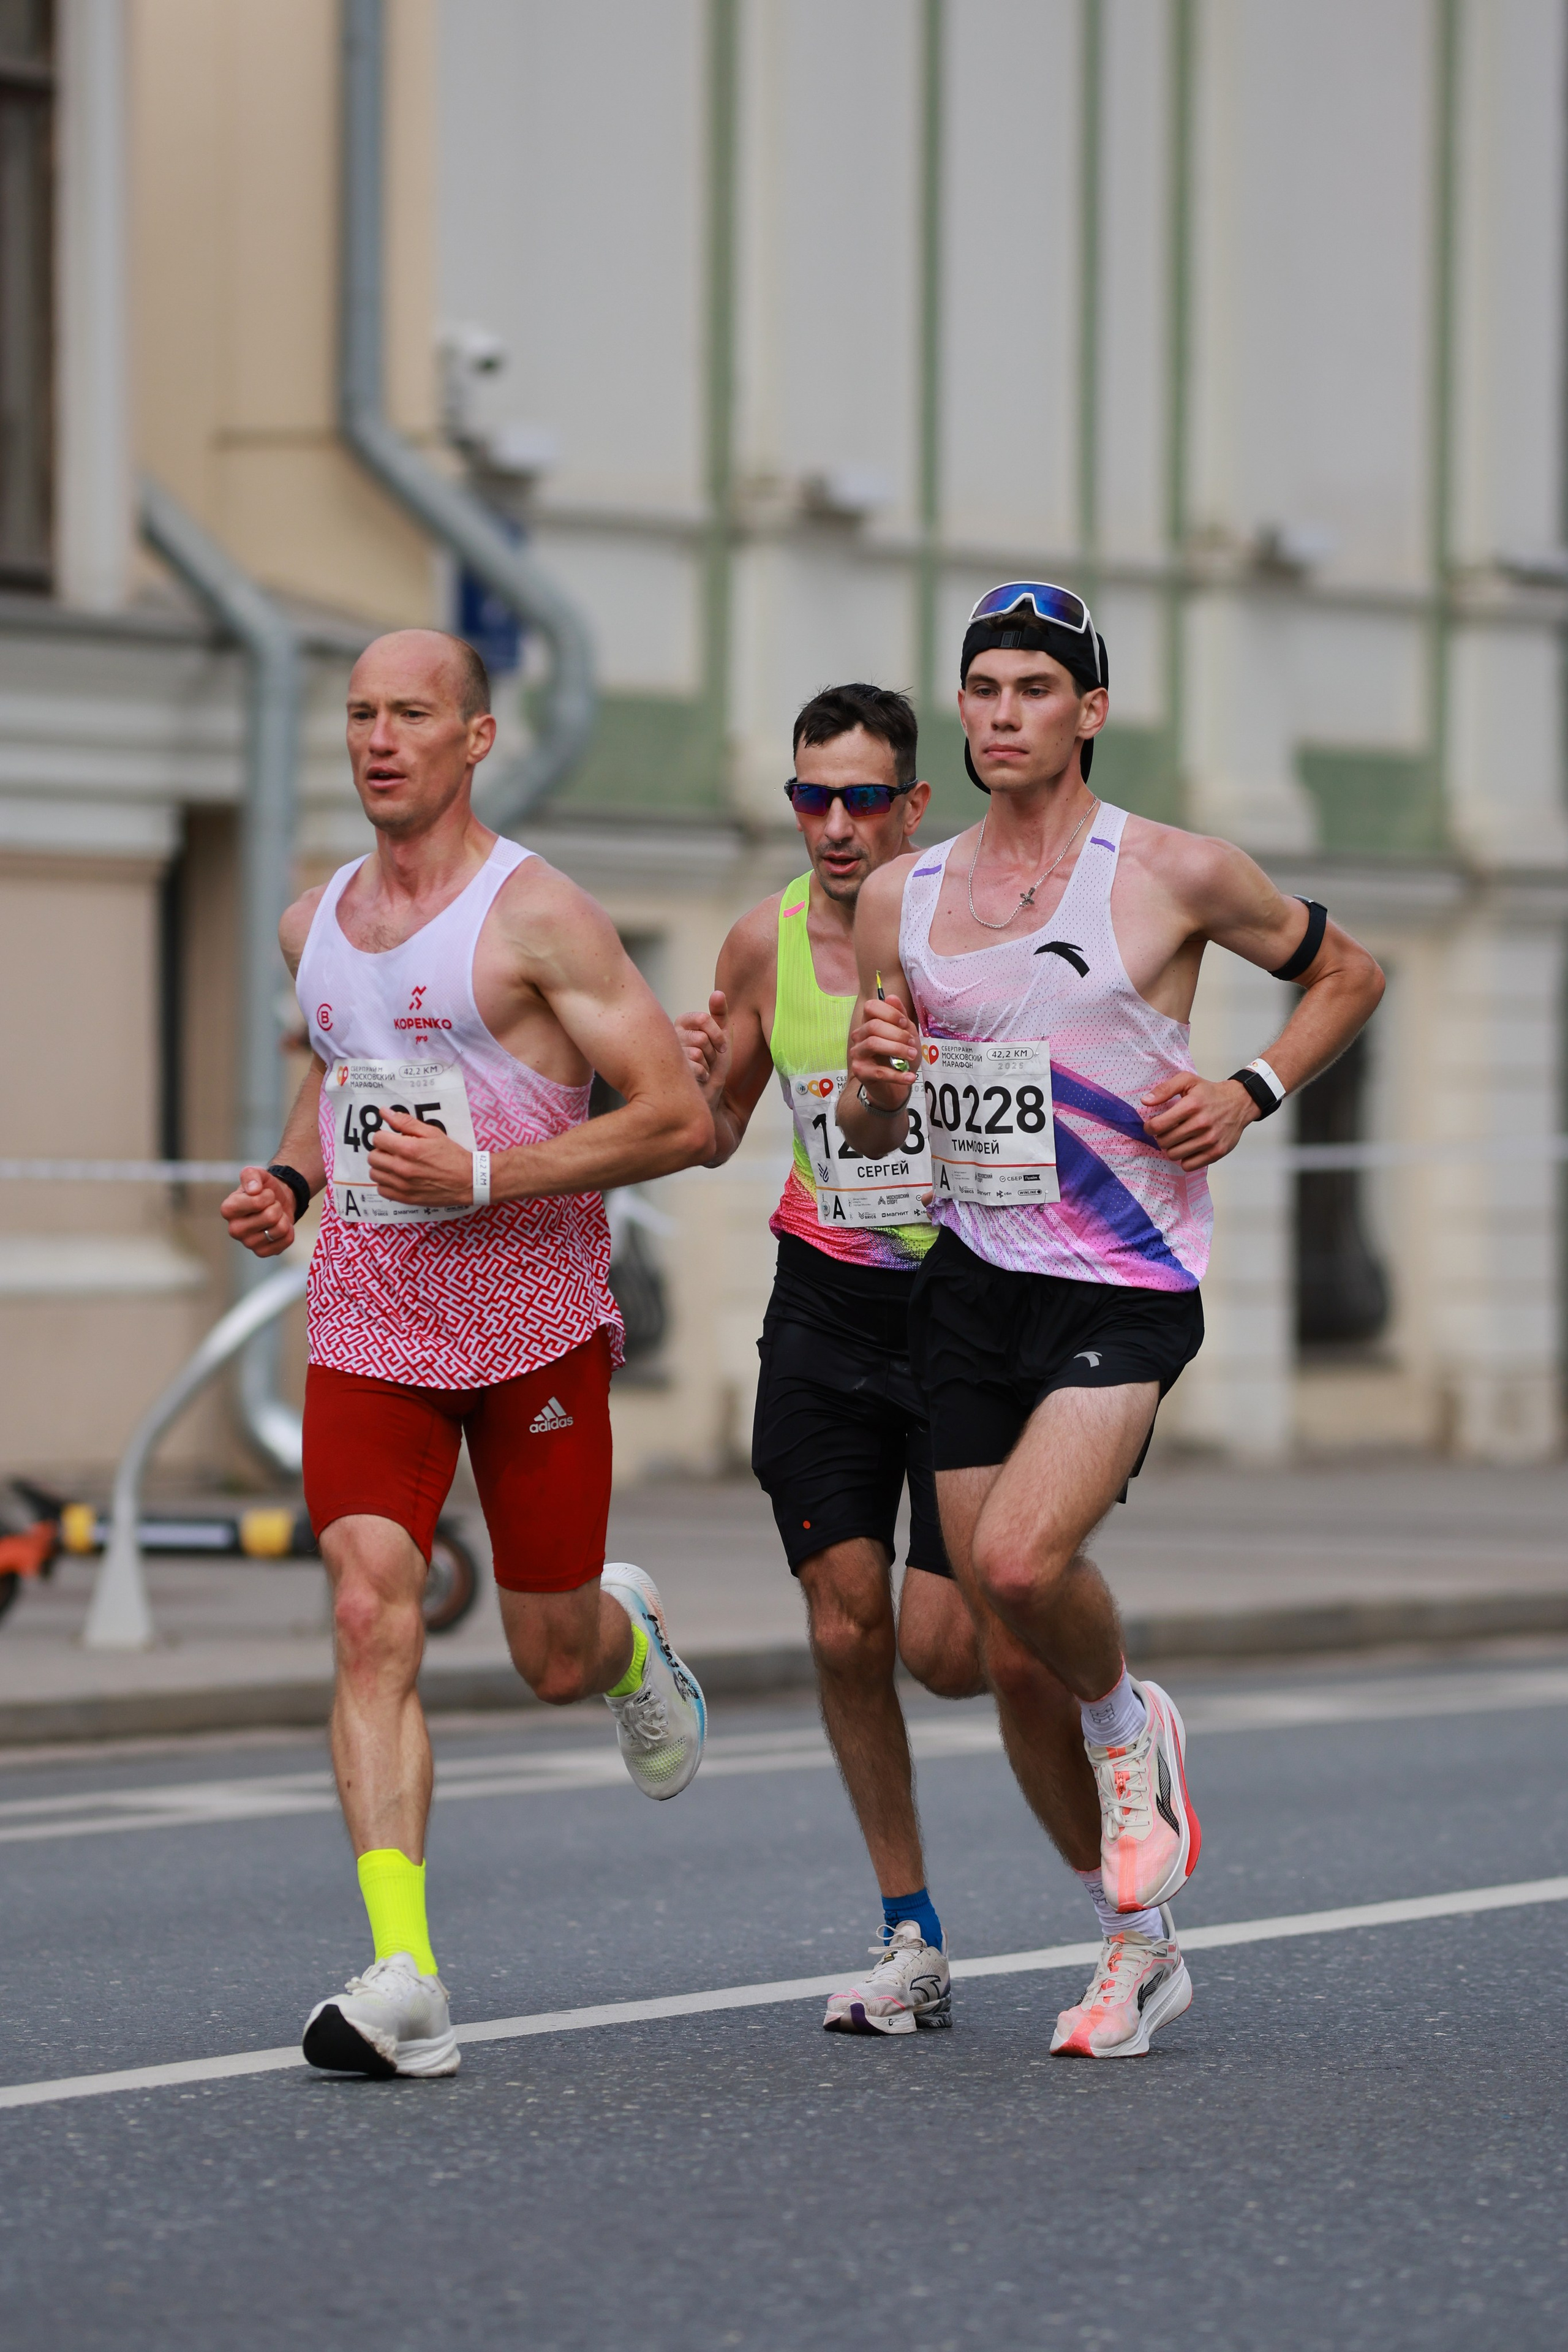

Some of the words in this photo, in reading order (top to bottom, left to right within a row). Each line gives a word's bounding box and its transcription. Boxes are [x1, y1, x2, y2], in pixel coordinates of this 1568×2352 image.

[394, 1017, 452, 1030] KOPENKO
[415, 1035, 428, 1045] pro
[941, 1052, 982, 1062] МОСКОВСКИЙ
[942, 1060, 973, 1069] МАРАФОН
[350, 1072, 396, 1080] МОСКОВСКИЙ
[924, 1080, 1046, 1134] 20228
[951, 1139, 1000, 1155] ТИМОФЕЙ
[858, 1160, 909, 1178] СЕРГЕЙ
[529, 1416, 574, 1433] adidas
